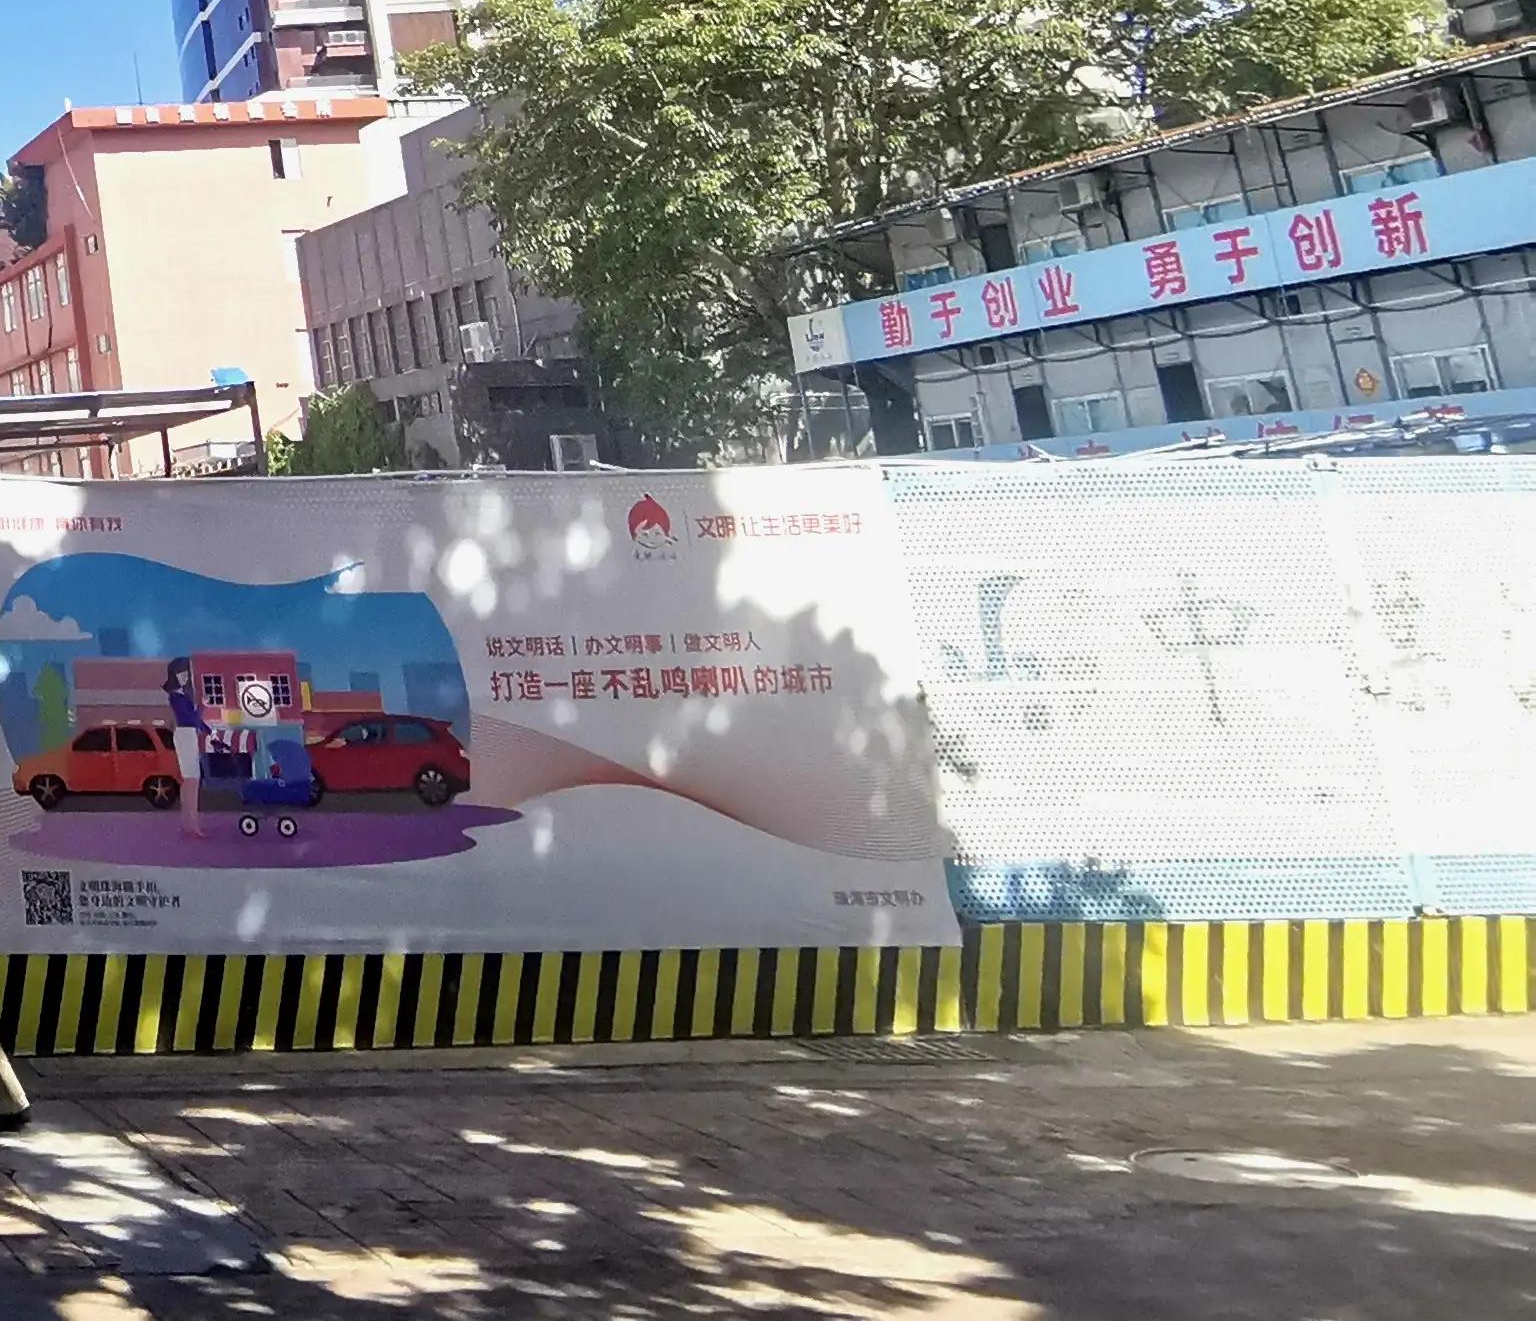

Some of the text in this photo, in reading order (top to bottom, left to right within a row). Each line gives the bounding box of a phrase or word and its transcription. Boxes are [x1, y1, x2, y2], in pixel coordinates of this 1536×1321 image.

[879, 191, 1428, 349] 勤于创业 勇于创新
[486, 631, 761, 658] 说文明话 办文明事 做文明人
